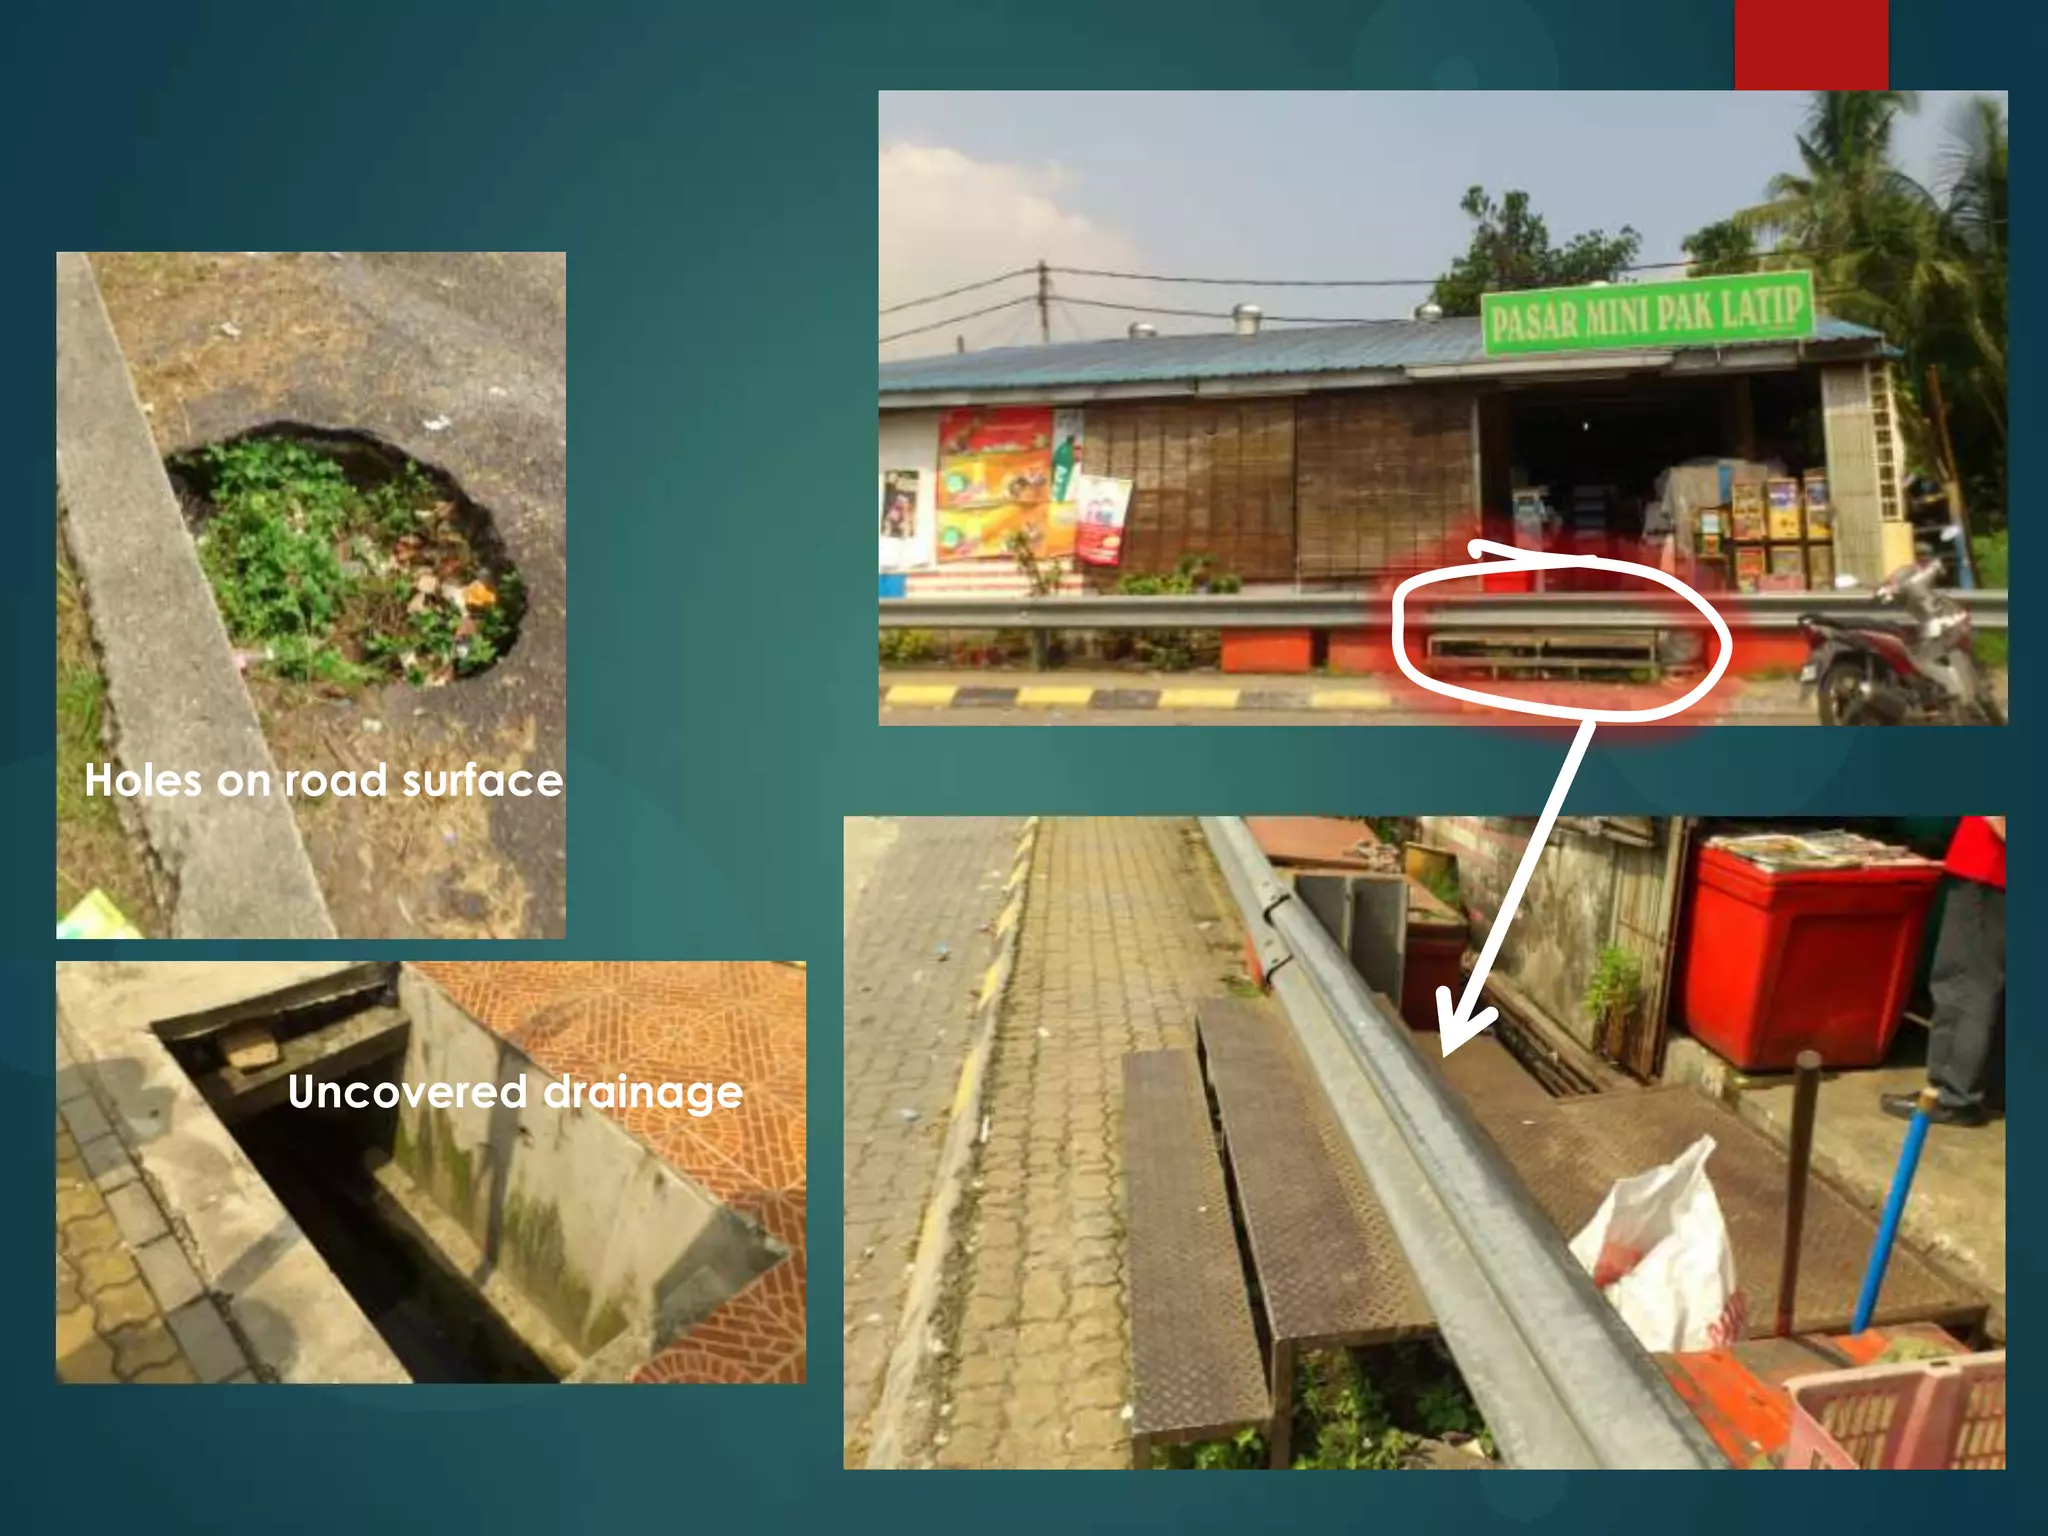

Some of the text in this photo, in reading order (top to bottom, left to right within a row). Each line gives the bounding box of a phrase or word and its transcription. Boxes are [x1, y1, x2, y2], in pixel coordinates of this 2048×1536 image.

[1491, 285, 1803, 343] PASAR MINI PAK LATIP
